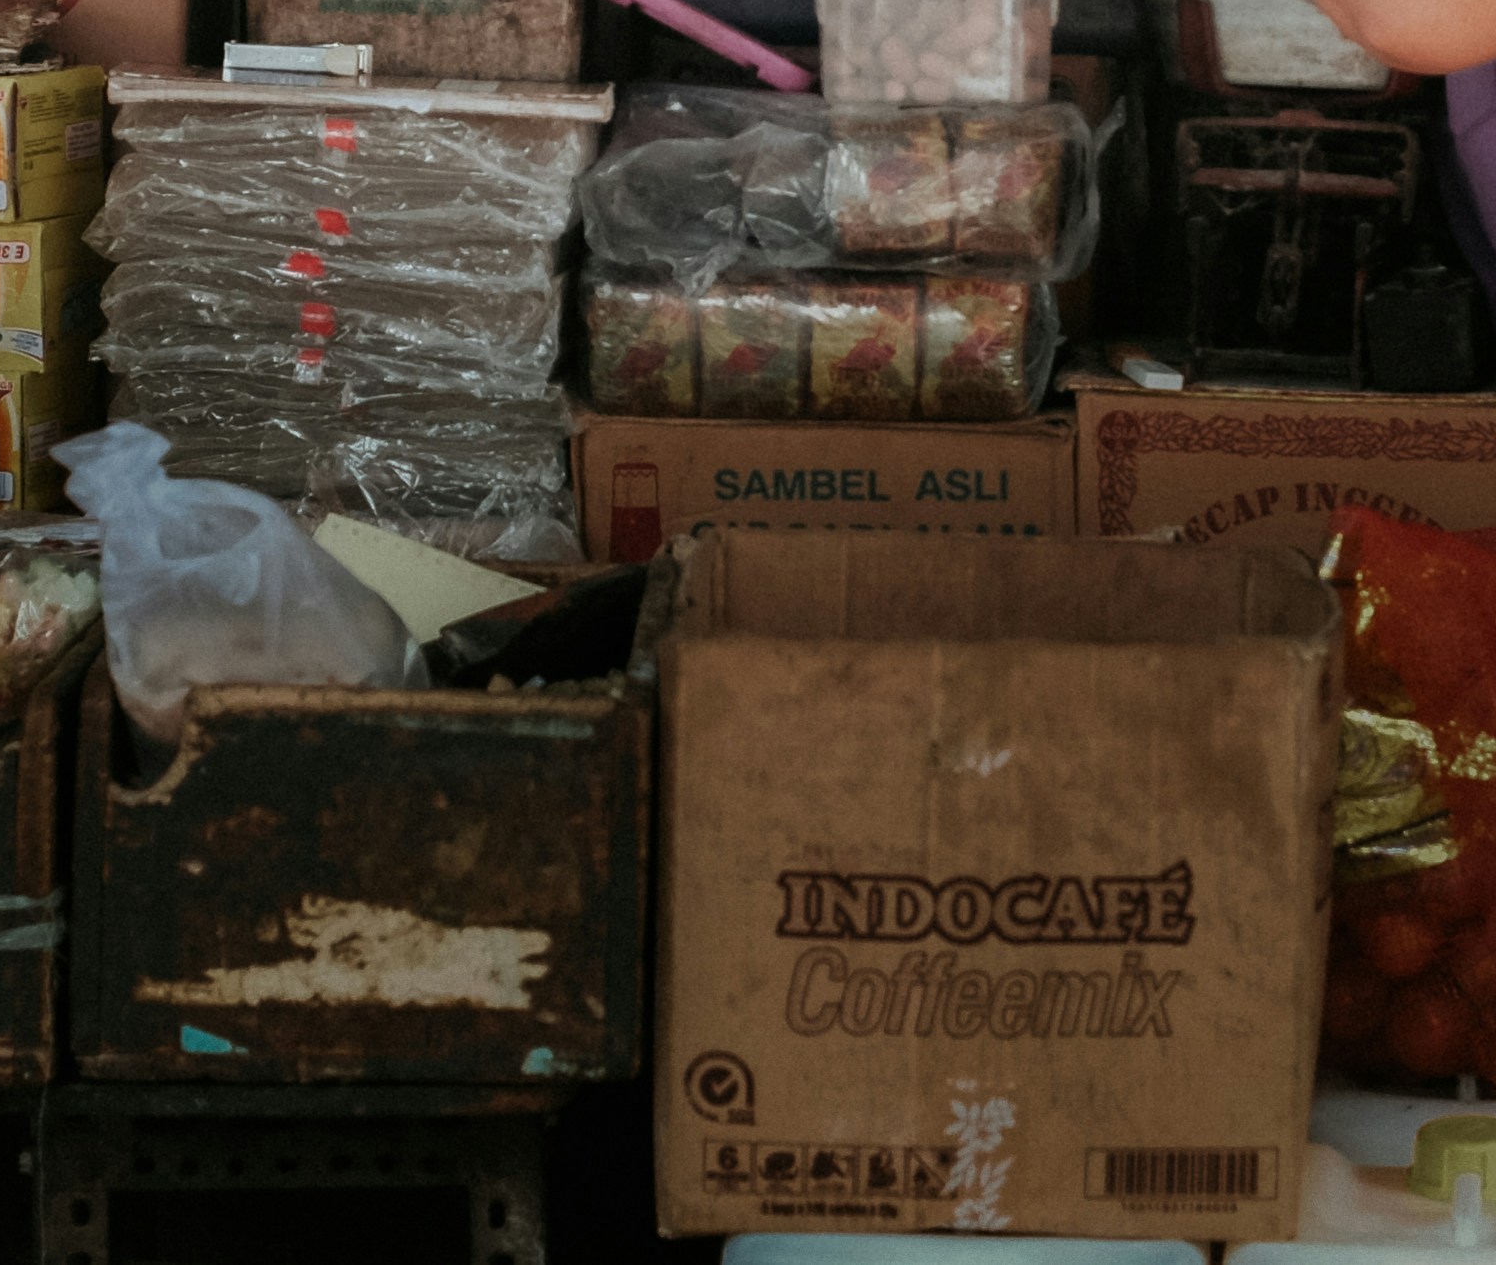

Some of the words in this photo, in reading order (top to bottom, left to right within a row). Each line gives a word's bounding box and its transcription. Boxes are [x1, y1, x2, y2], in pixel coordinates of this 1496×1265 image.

[714, 468, 891, 502] SAMBEL
[915, 470, 1010, 502] ASLI
[774, 857, 1196, 946] INDOCAFÉ
[784, 945, 1184, 1040] Coffeemix
[717, 1145, 739, 1170] 6
